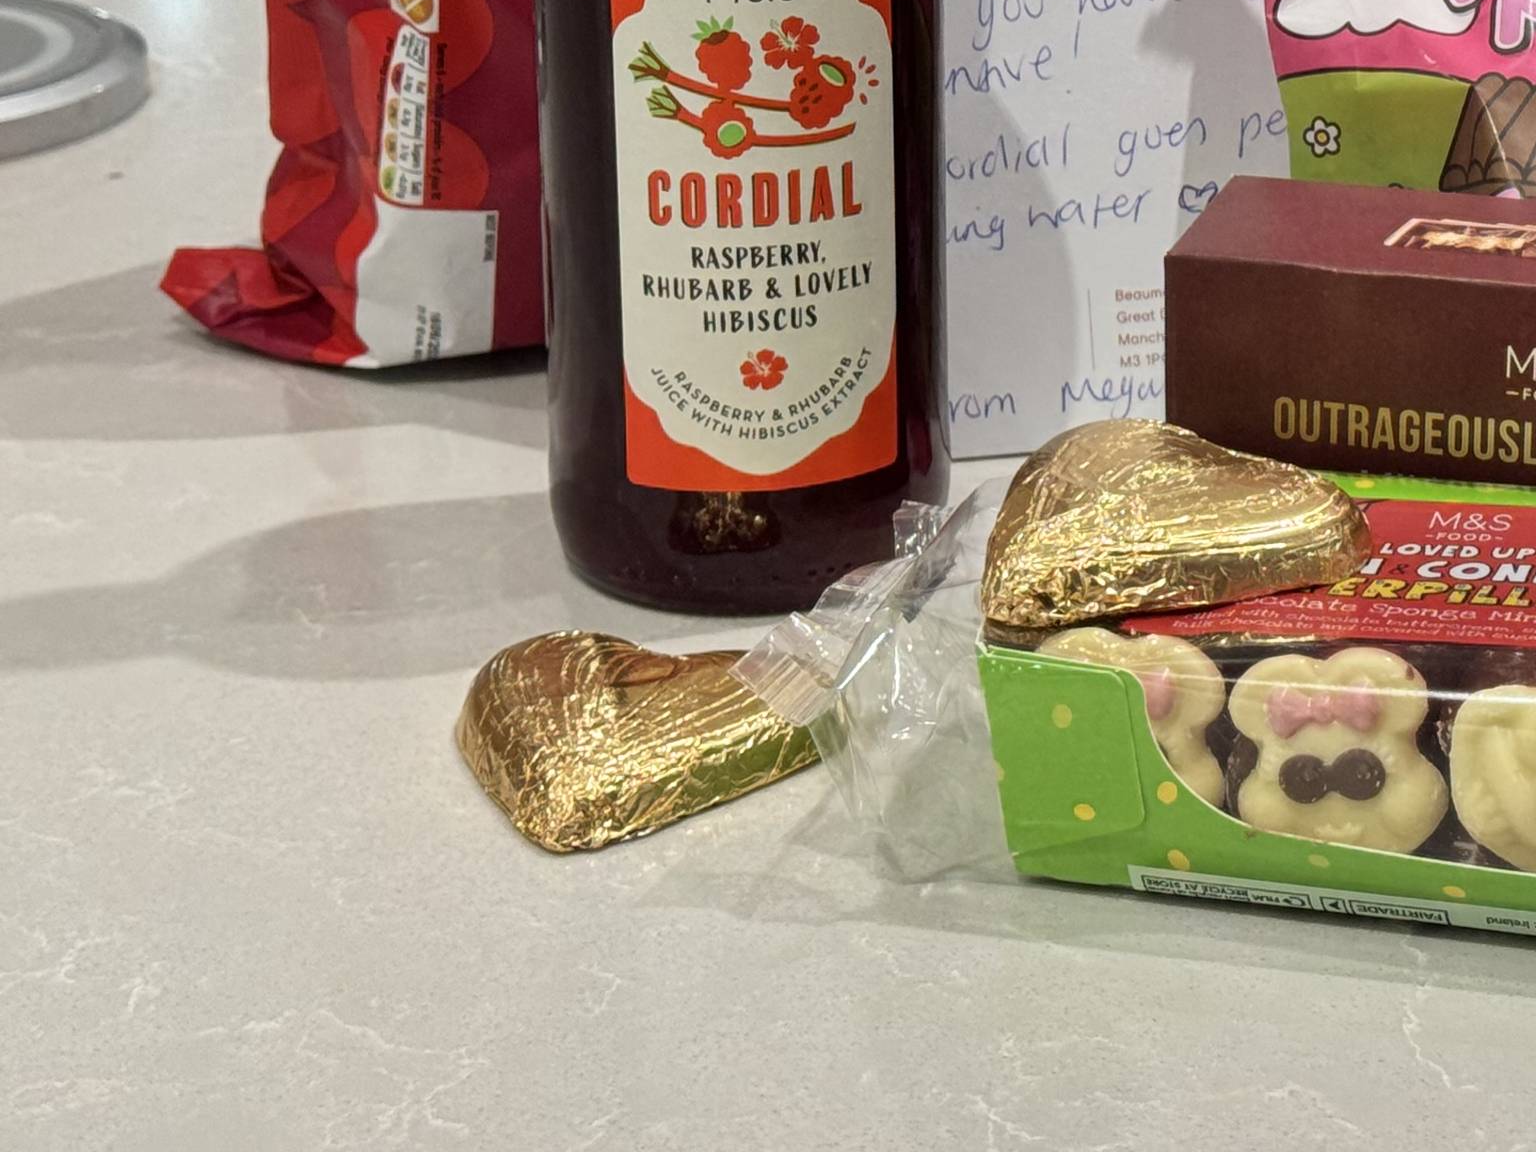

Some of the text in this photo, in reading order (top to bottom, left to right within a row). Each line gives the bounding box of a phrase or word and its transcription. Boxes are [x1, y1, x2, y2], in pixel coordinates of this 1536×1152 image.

[647, 160, 863, 229] CORDIAL
[1029, 188, 1151, 230] water
[691, 239, 827, 269] RASPBERRY,
[642, 261, 872, 301] RHUBARB & LOVELY
[703, 304, 818, 333] HIBISCUS
[650, 347, 872, 440] JUICE WITH HIBISCUS EXTRACT
[674, 354, 853, 423] RASPBERRY & RHUBARB
[1429, 511, 1514, 533] M&S
[1380, 542, 1536, 561] LOVED UP
[1435, 532, 1493, 543] FOOD
[1369, 603, 1477, 621] Sponge
[1356, 905, 1443, 922] FAIRTRADE
[1485, 916, 1531, 929] Ireland
